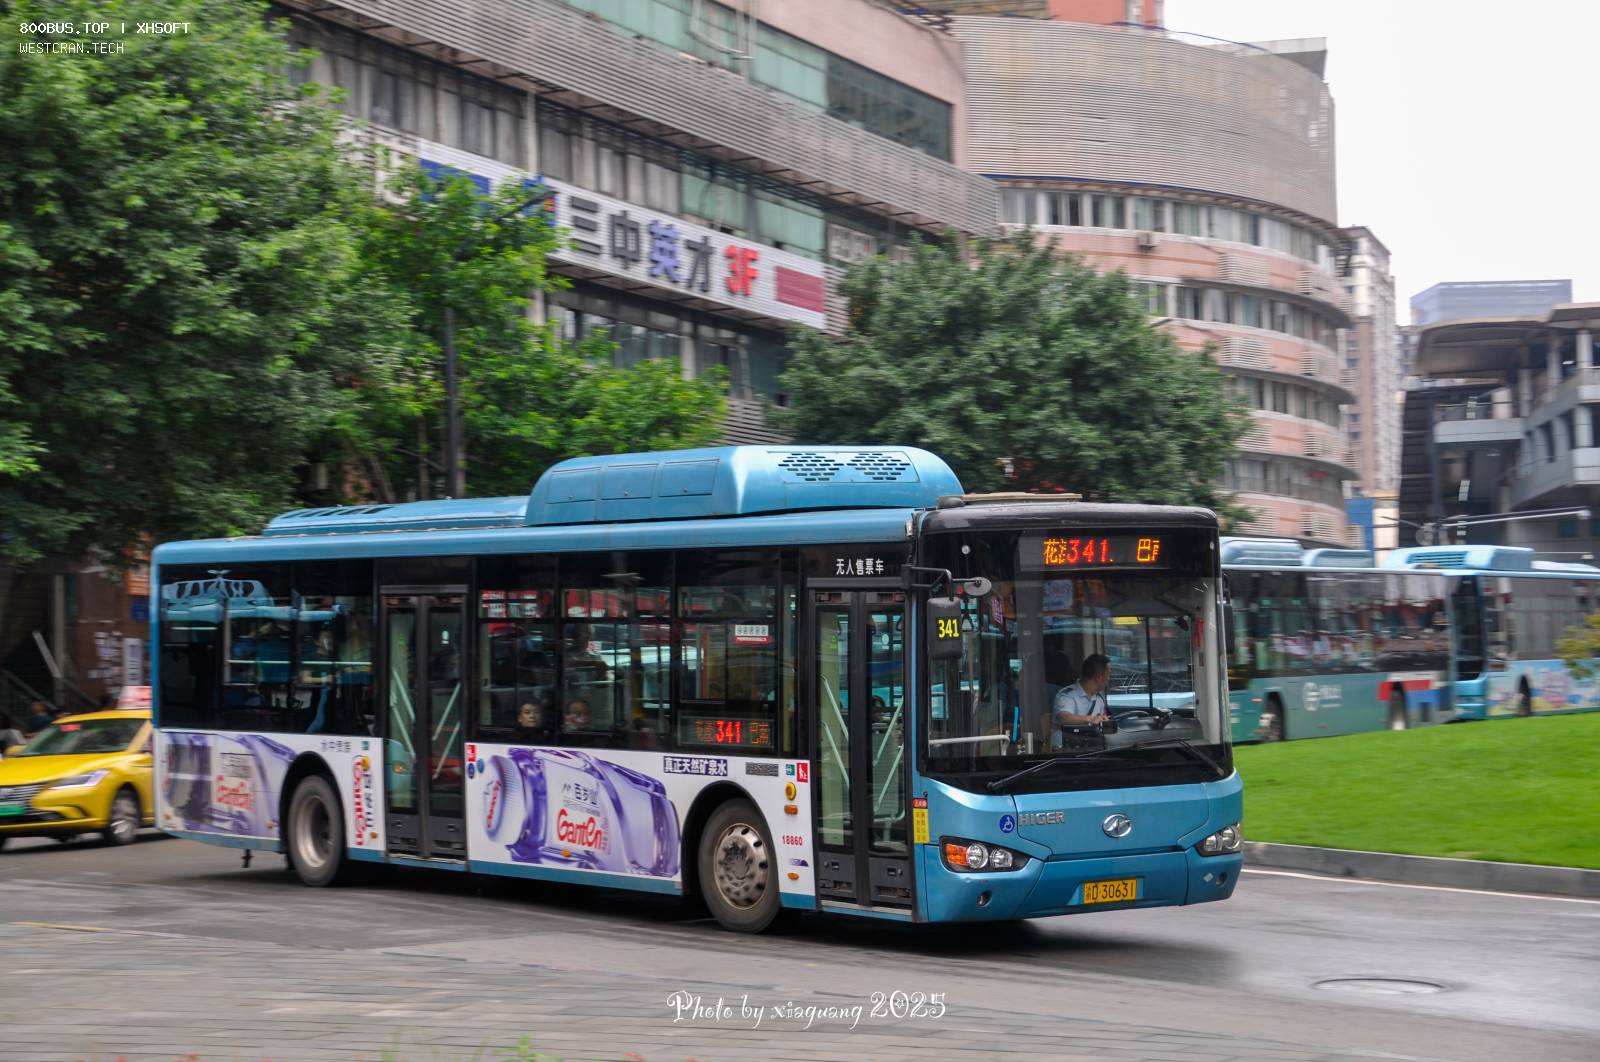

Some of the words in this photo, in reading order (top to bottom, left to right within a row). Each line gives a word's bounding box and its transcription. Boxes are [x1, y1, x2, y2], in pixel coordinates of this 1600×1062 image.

[571, 195, 714, 293] 三中英才
[725, 244, 761, 297] 3F
[1066, 538, 1110, 563] 341
[835, 558, 885, 576] 无人售票车
[938, 618, 960, 639] 341
[714, 719, 742, 745] 341
[664, 756, 727, 776] 真正天然矿泉水
[557, 808, 603, 850] Ganten
[1018, 811, 1065, 826] HIGER
[782, 835, 803, 846] 18860
